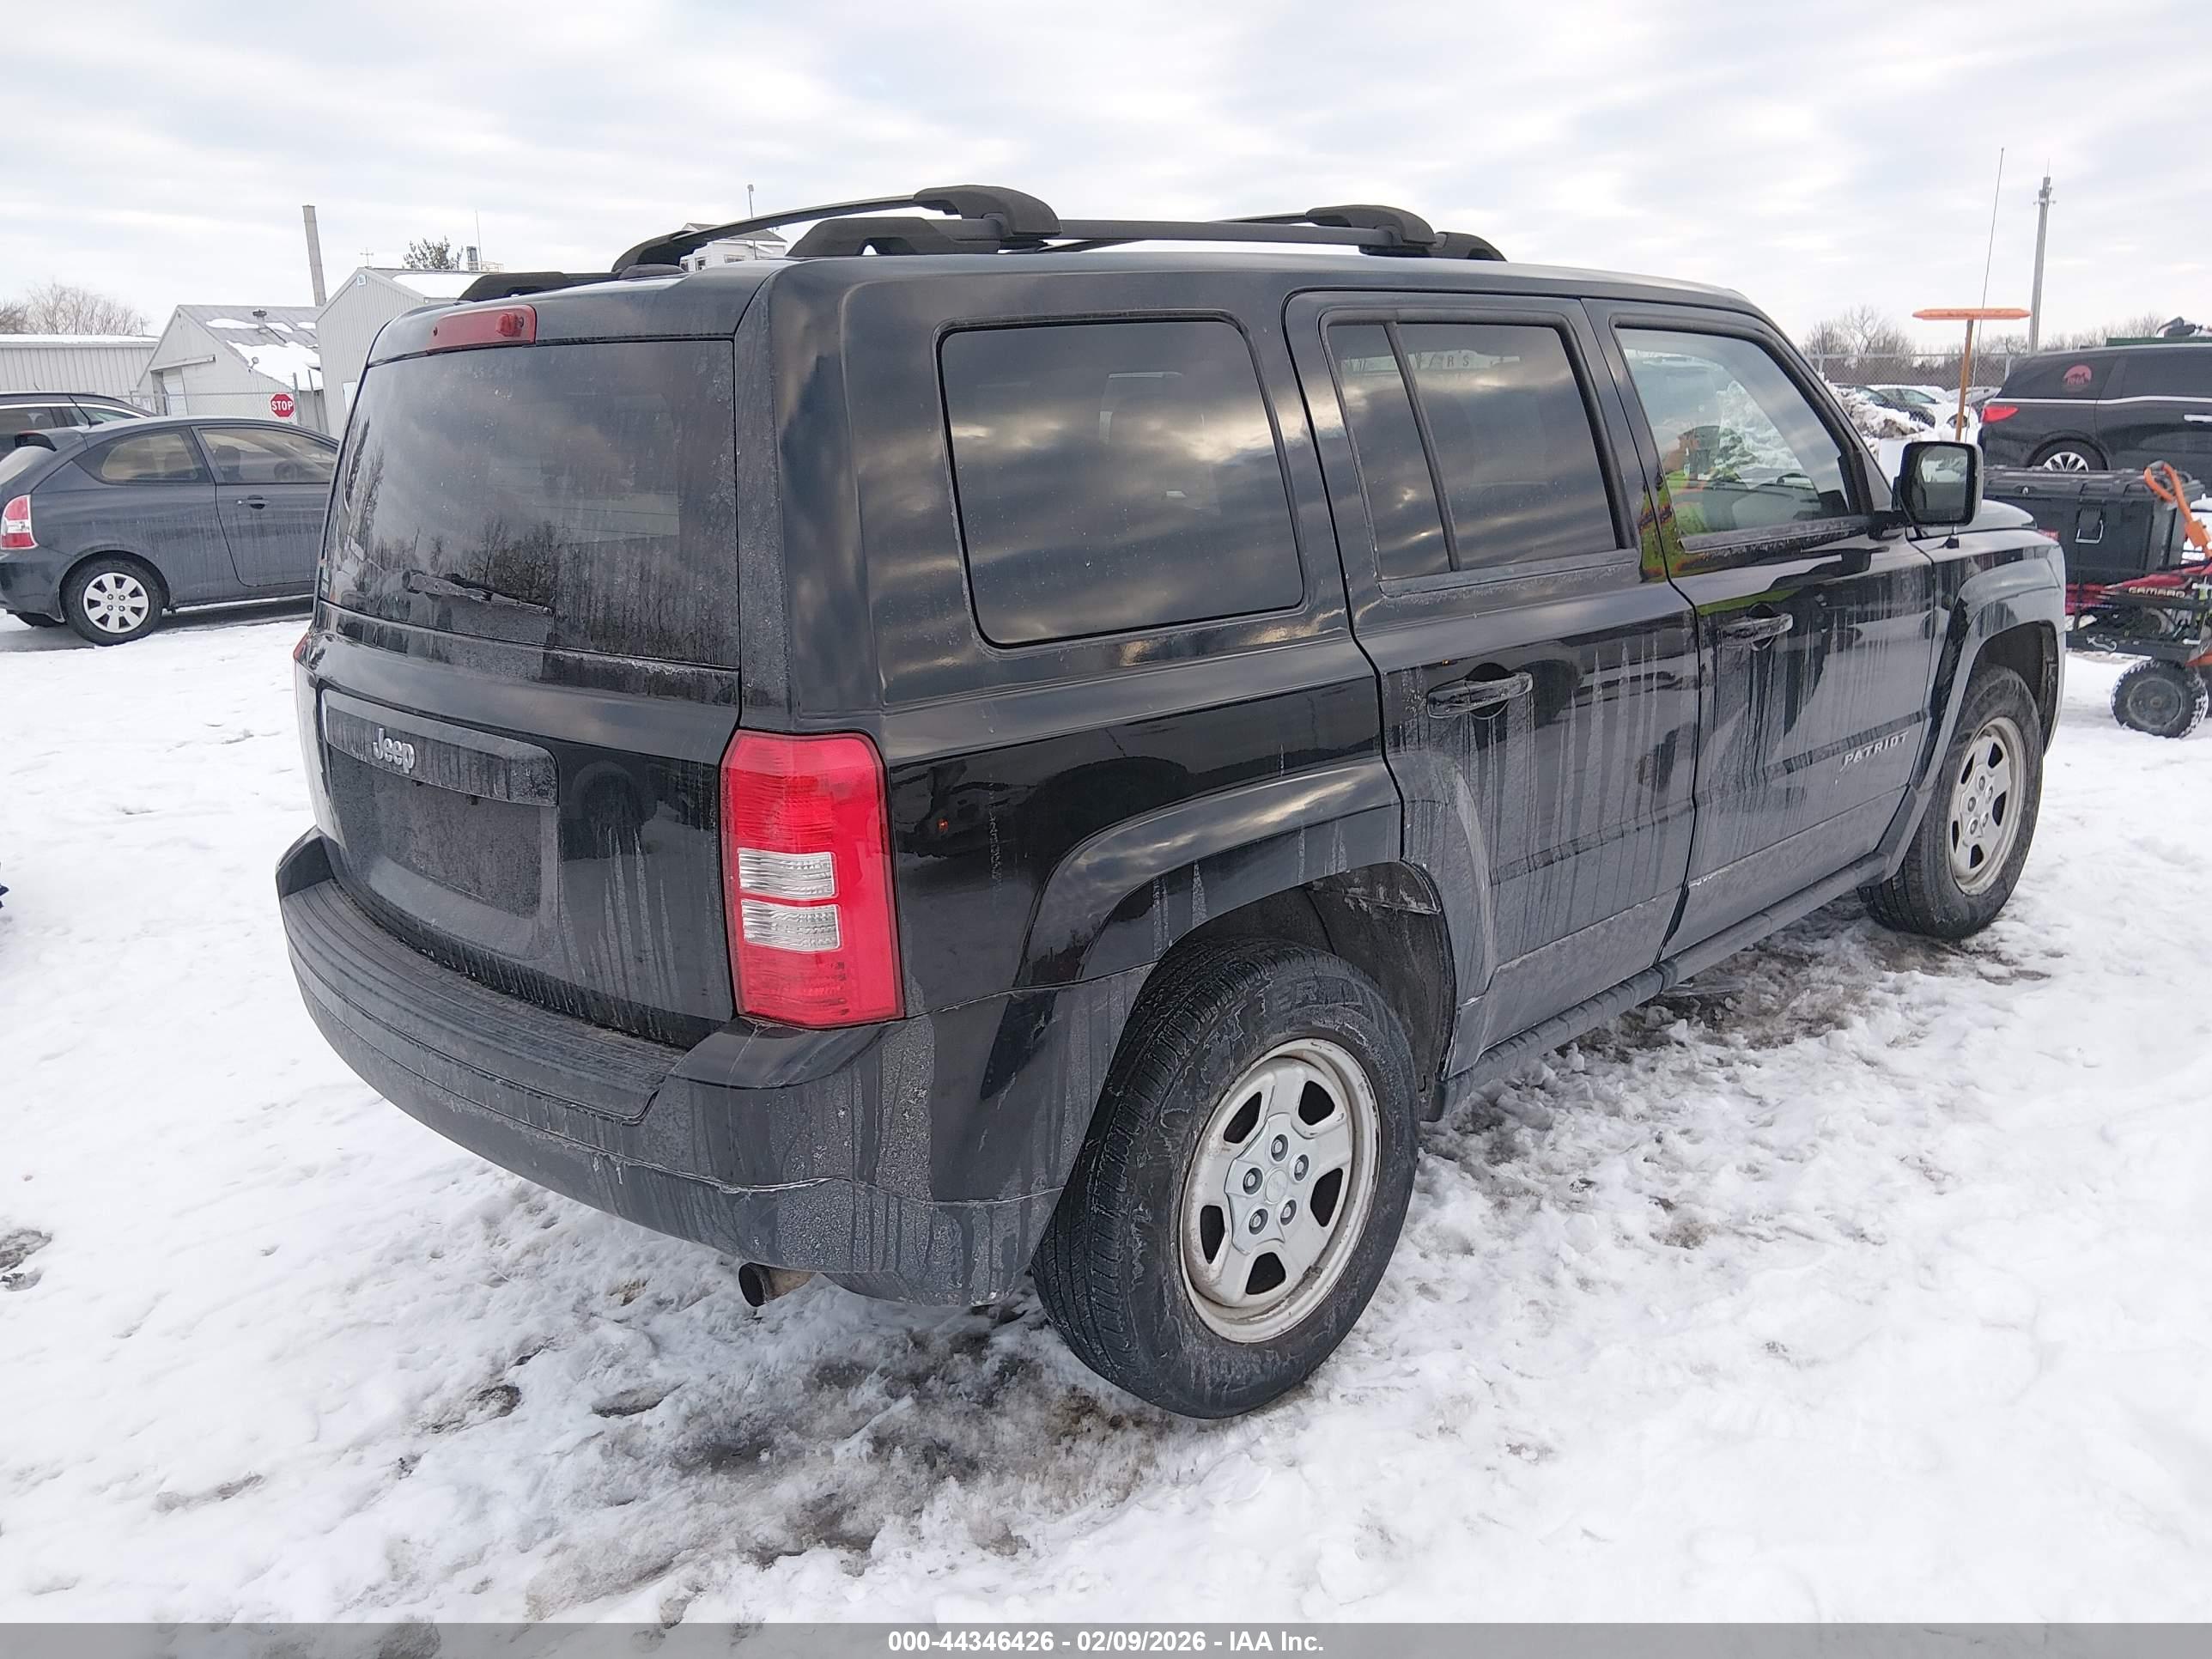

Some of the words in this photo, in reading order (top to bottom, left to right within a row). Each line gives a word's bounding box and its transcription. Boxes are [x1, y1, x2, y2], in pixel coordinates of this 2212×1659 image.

[271, 400, 293, 411] STOP
[373, 727, 415, 774] Jeep
[1842, 731, 1909, 769] PATRIOT
